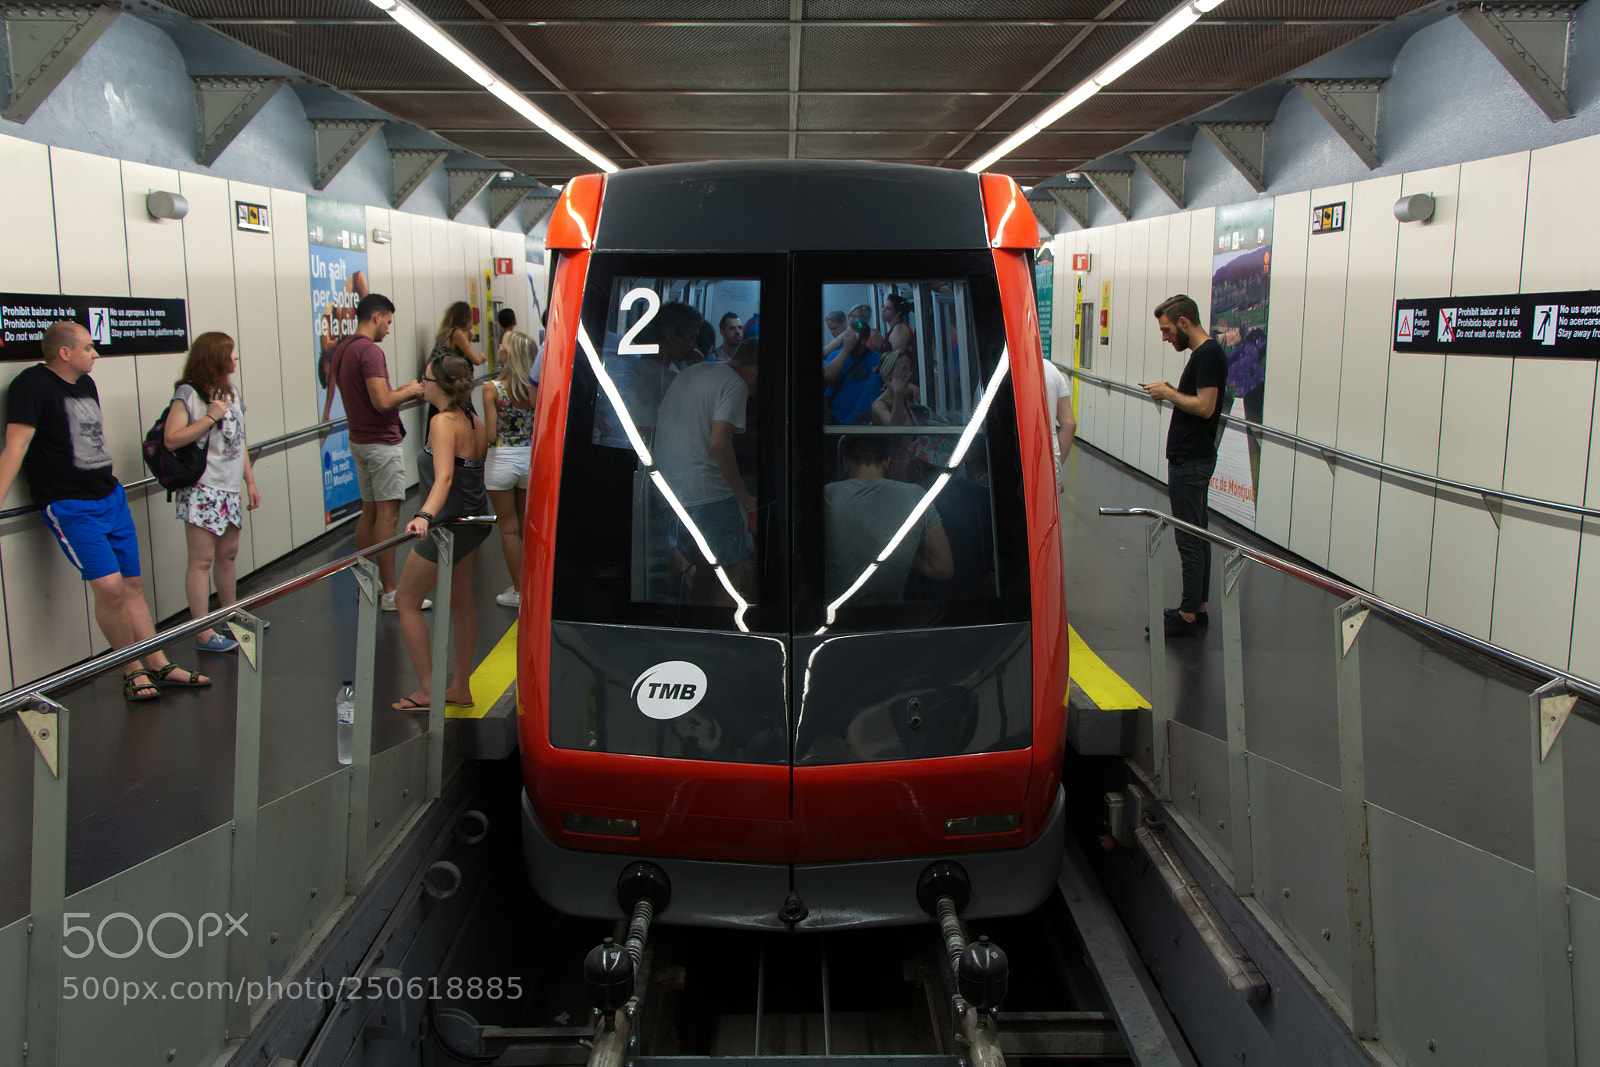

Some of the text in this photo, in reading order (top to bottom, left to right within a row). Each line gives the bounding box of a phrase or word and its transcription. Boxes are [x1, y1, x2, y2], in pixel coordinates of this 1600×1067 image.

[311, 254, 346, 280] Un salt
[312, 287, 360, 312] per sobre
[2, 305, 30, 316] Prohibit
[31, 306, 52, 316] baixar
[59, 306, 65, 316] la
[110, 308, 117, 316] No
[1415, 308, 1427, 316] Perill
[1458, 307, 1479, 316] Prohibit
[1480, 306, 1498, 316] baixar
[1504, 306, 1510, 315] la
[1560, 304, 1570, 313] No
[3, 318, 36, 328] Prohibido
[110, 318, 118, 326] No
[147, 318, 161, 326] borde
[314, 314, 328, 336] de
[329, 313, 339, 336] la
[617, 287, 661, 355] 2
[1414, 319, 1430, 328] Peligro
[1457, 318, 1482, 327] Prohibido
[1482, 318, 1498, 329] bajar
[1503, 317, 1509, 327] la
[1559, 316, 1569, 325] No
[4, 330, 43, 341] Do not walk
[111, 328, 122, 338] Stay
[123, 330, 135, 338] away
[135, 328, 147, 336] from
[1413, 328, 1430, 337] Danger
[1456, 330, 1464, 338] Do
[1473, 329, 1487, 338] walk
[1495, 329, 1505, 338] the
[1506, 329, 1522, 338] track
[1557, 328, 1573, 339] Stay
[1573, 330, 1592, 339] away
[1220, 477, 1227, 492] de
[648, 682, 697, 700] TMB
